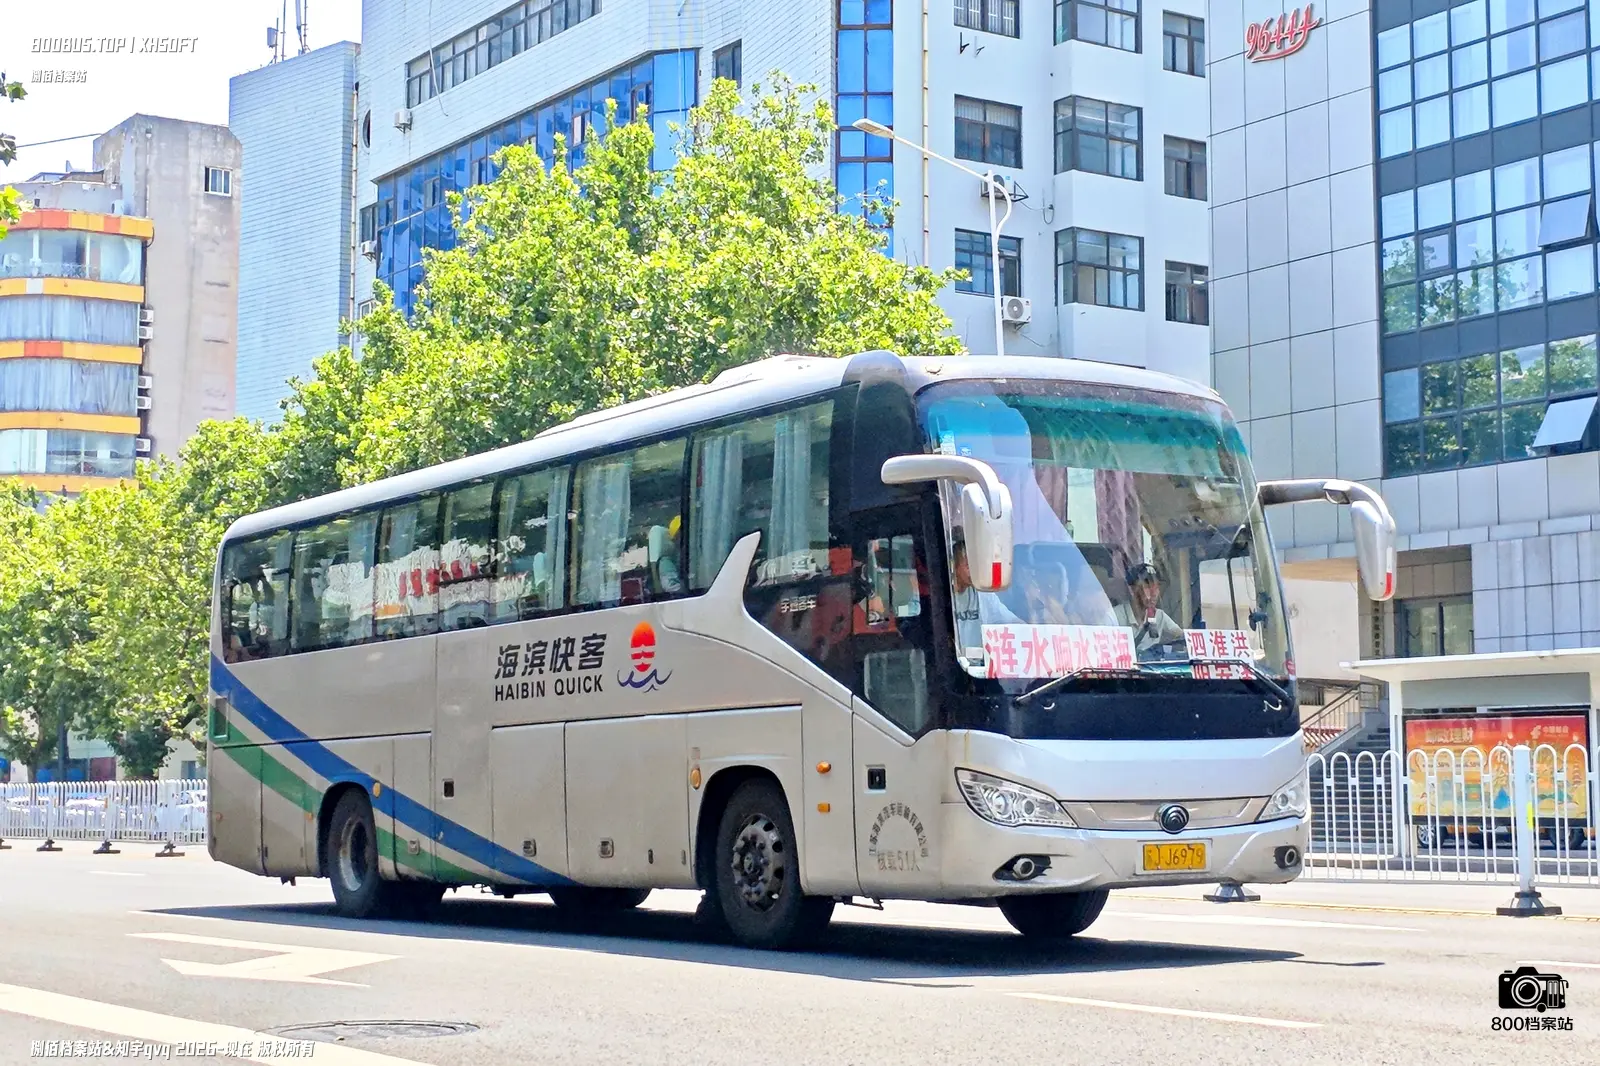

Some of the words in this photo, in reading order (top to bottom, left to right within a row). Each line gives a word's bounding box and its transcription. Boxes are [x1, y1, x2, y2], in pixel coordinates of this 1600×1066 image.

[1245, 2, 1321, 62] 96444
[494, 633, 607, 679] 海滨快客
[494, 681, 546, 701] HAIBIN
[554, 674, 604, 696] QUICK
